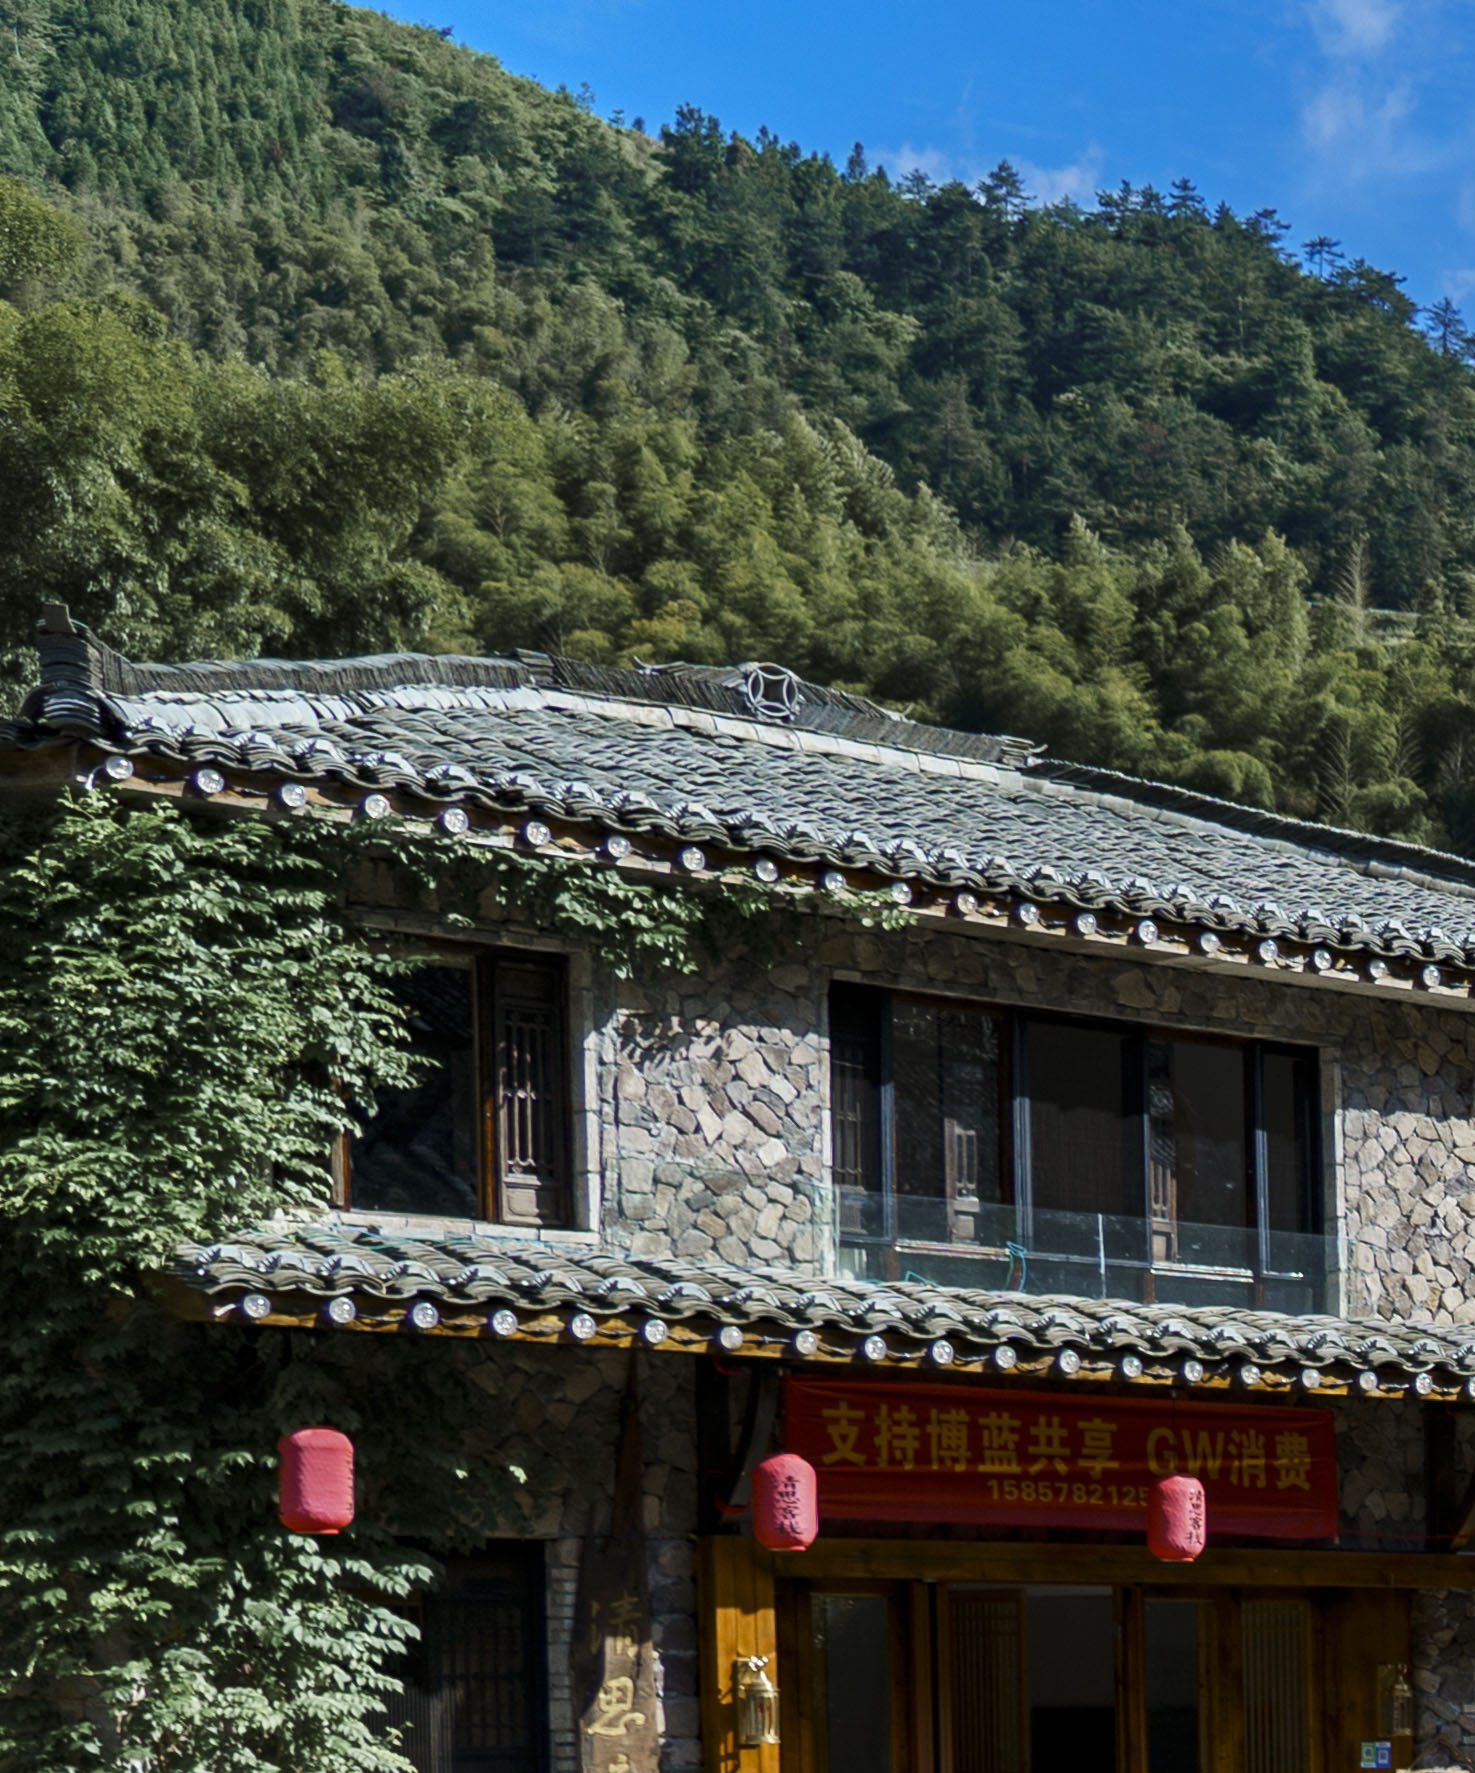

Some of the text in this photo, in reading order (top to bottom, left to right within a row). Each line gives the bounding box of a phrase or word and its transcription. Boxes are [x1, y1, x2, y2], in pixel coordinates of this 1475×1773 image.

[821, 1402, 1312, 1491] 支持博蓝共享 GW消费
